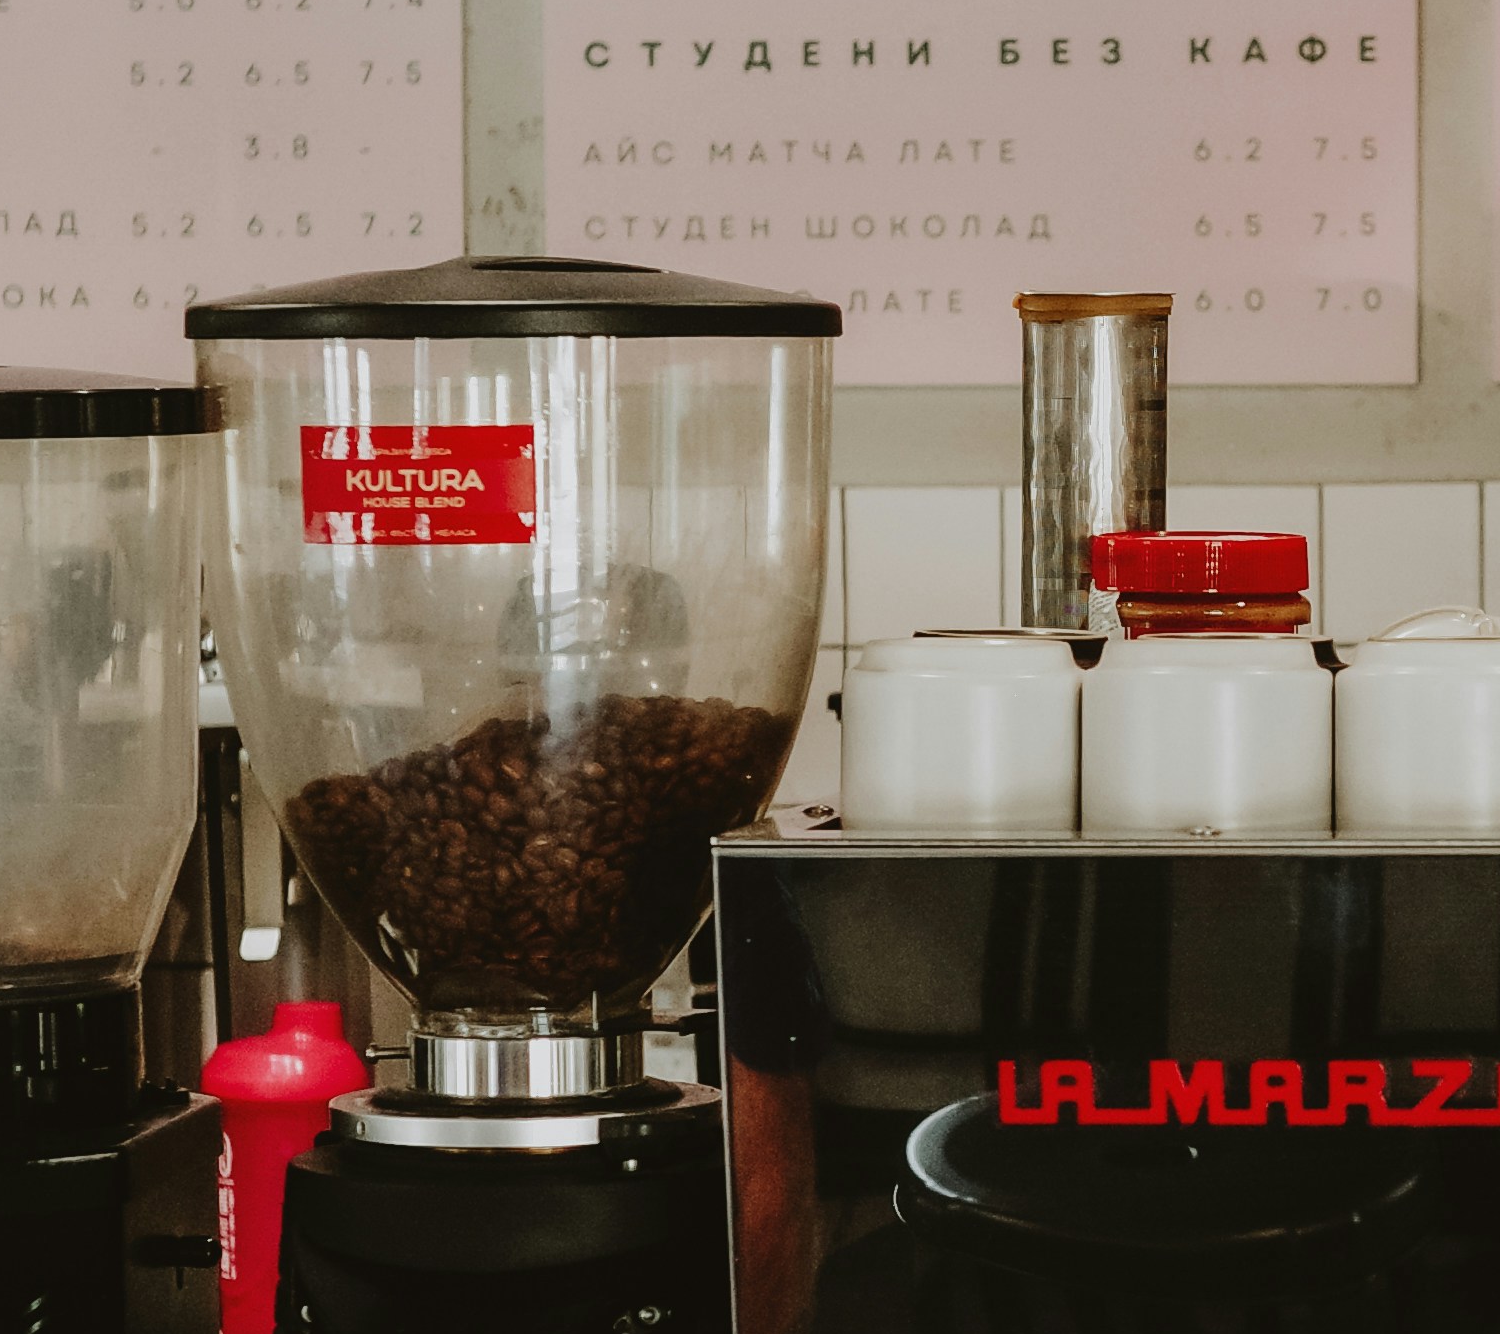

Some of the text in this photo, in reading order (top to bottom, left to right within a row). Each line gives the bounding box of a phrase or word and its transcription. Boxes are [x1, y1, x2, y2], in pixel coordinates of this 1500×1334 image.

[583, 35, 1376, 72] СТУДЕНИ БЕЗ КАФЕ
[244, 60, 311, 86] 6.5
[361, 59, 422, 86] 7.5
[583, 135, 1378, 166] АЙС МАТЧА ЛАТЕ 6.2 7.5
[131, 212, 196, 238] 5.2
[246, 212, 313, 238] 6.5
[584, 211, 1377, 243] СТУДЕН ШОКОЛАД 7.5
[133, 284, 200, 310] 6.2
[847, 287, 1266, 314] ЛАТЕ 6.0
[346, 469, 485, 492] KULTURA
[363, 497, 465, 508] HOUSE BLEND
[998, 1059, 1095, 1126] LA
